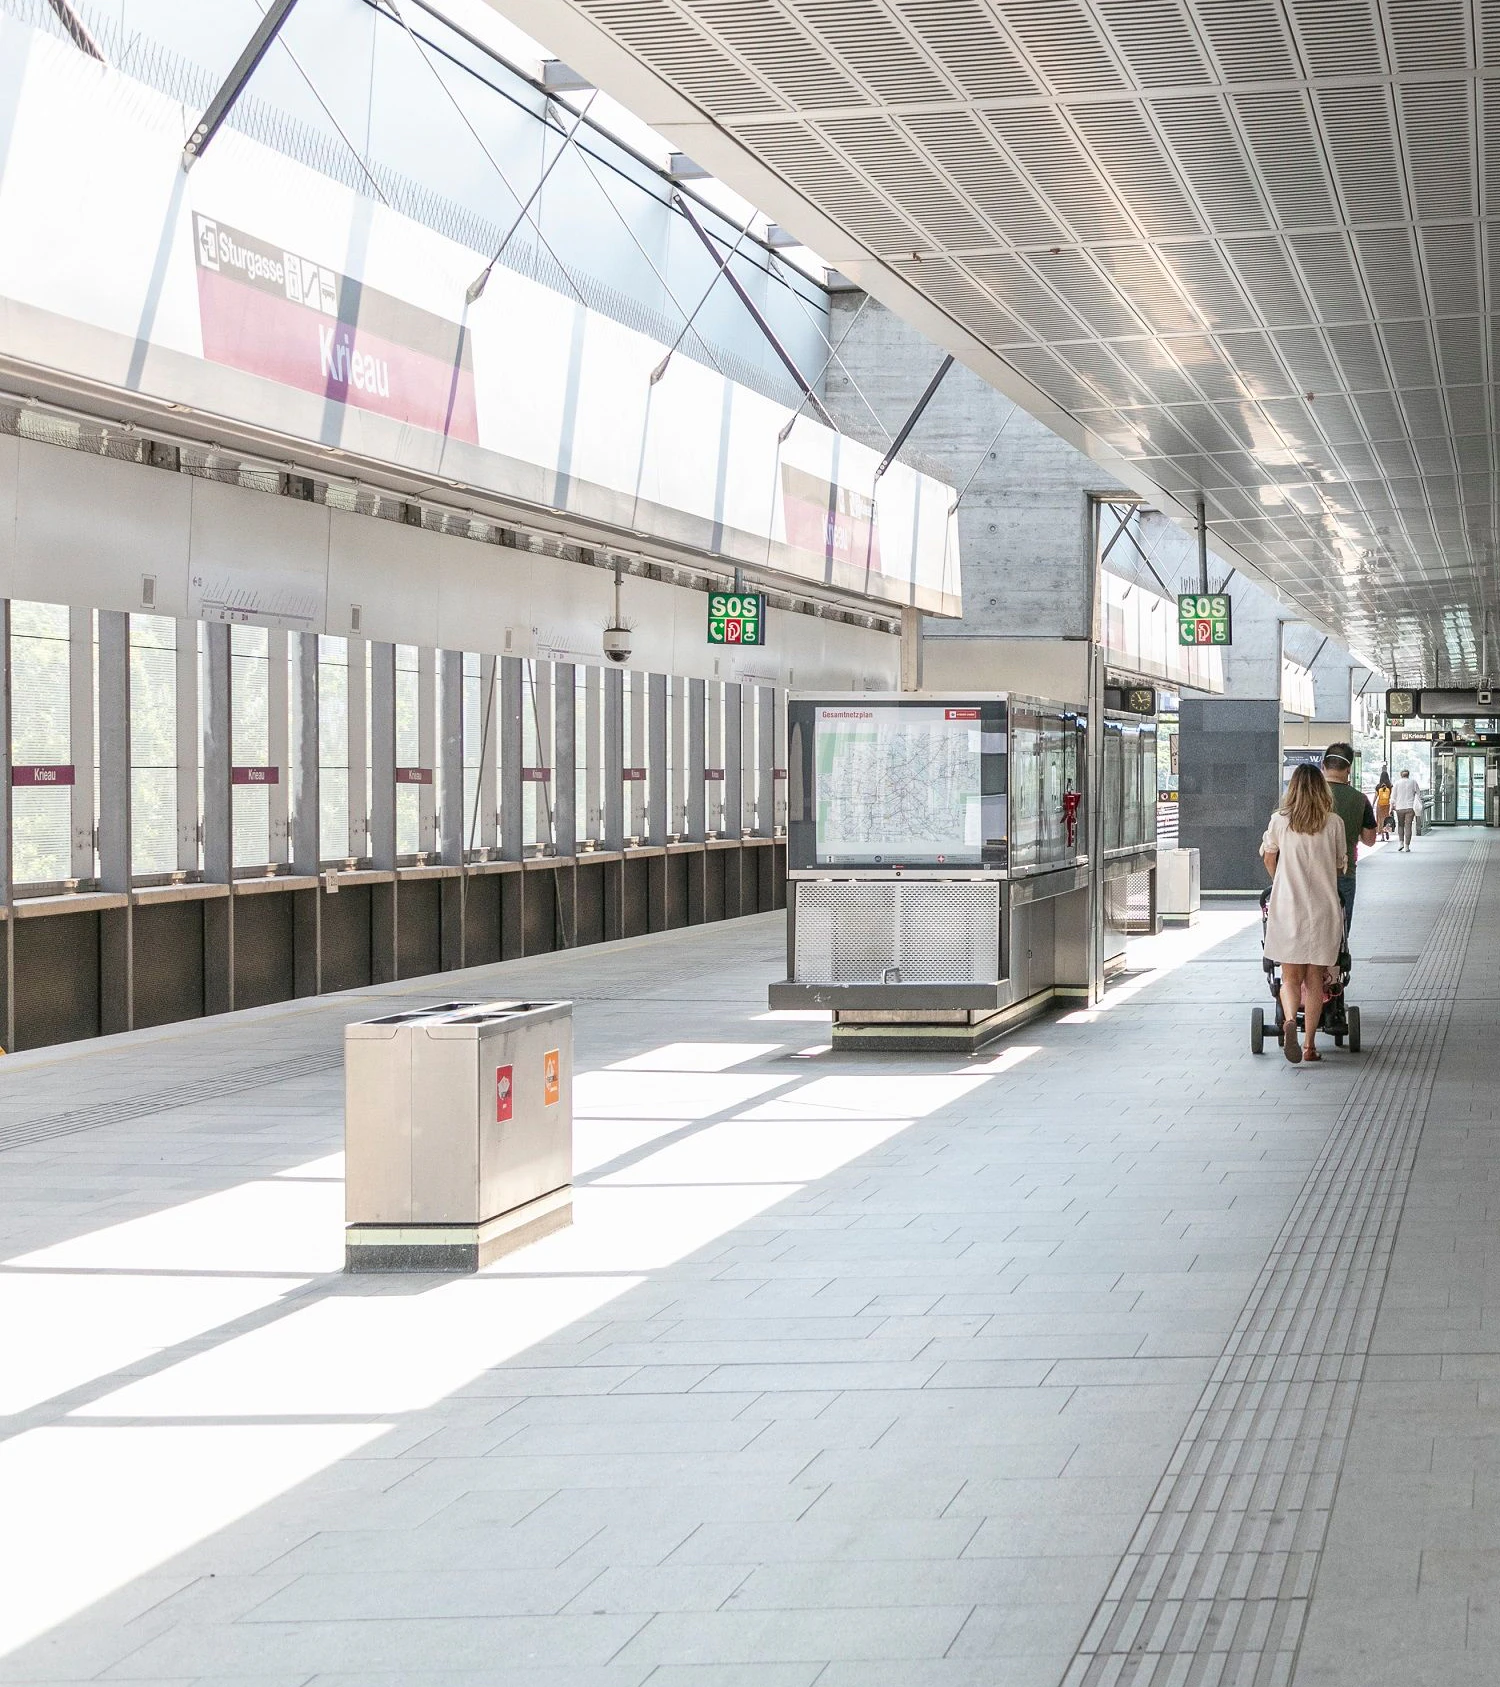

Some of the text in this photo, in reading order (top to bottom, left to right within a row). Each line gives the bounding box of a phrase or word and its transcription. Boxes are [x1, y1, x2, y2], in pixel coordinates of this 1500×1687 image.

[220, 233, 284, 283] Sturgasse
[319, 325, 389, 397] Krieau
[711, 596, 757, 617] SOS
[1181, 597, 1226, 618] SOS
[822, 711, 873, 720] Gesamtnetzplan
[34, 768, 56, 780] Krieau
[248, 769, 265, 780] Krieau
